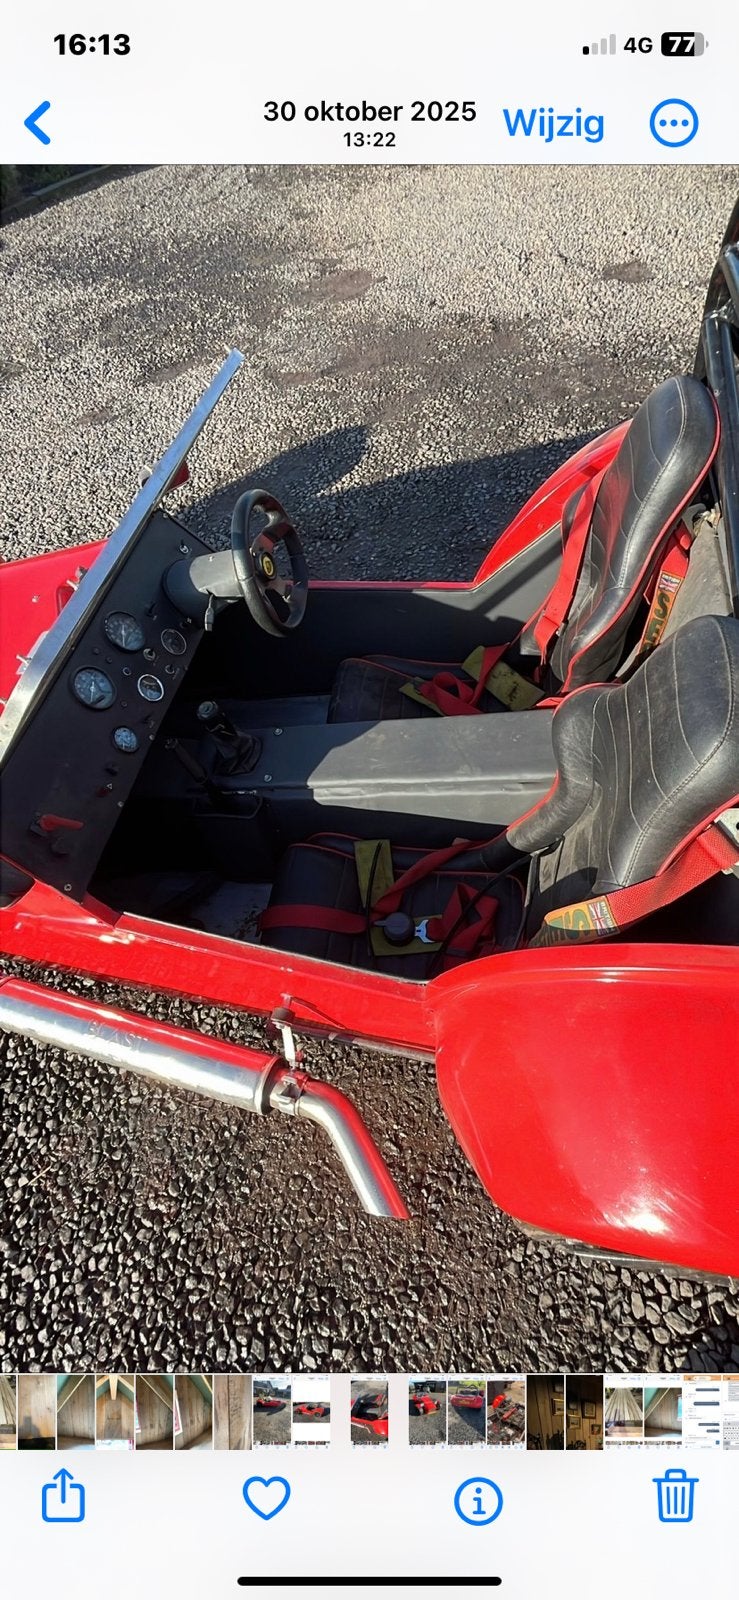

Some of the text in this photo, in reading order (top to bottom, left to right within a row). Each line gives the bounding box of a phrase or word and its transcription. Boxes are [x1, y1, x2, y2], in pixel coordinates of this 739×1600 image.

[53, 33, 131, 56] 16:13
[623, 36, 653, 54] 4G
[668, 36, 696, 53] 77
[263, 100, 477, 122] 30 oktober 2025
[502, 107, 605, 144] Wijzig
[343, 131, 396, 148] 13:22
